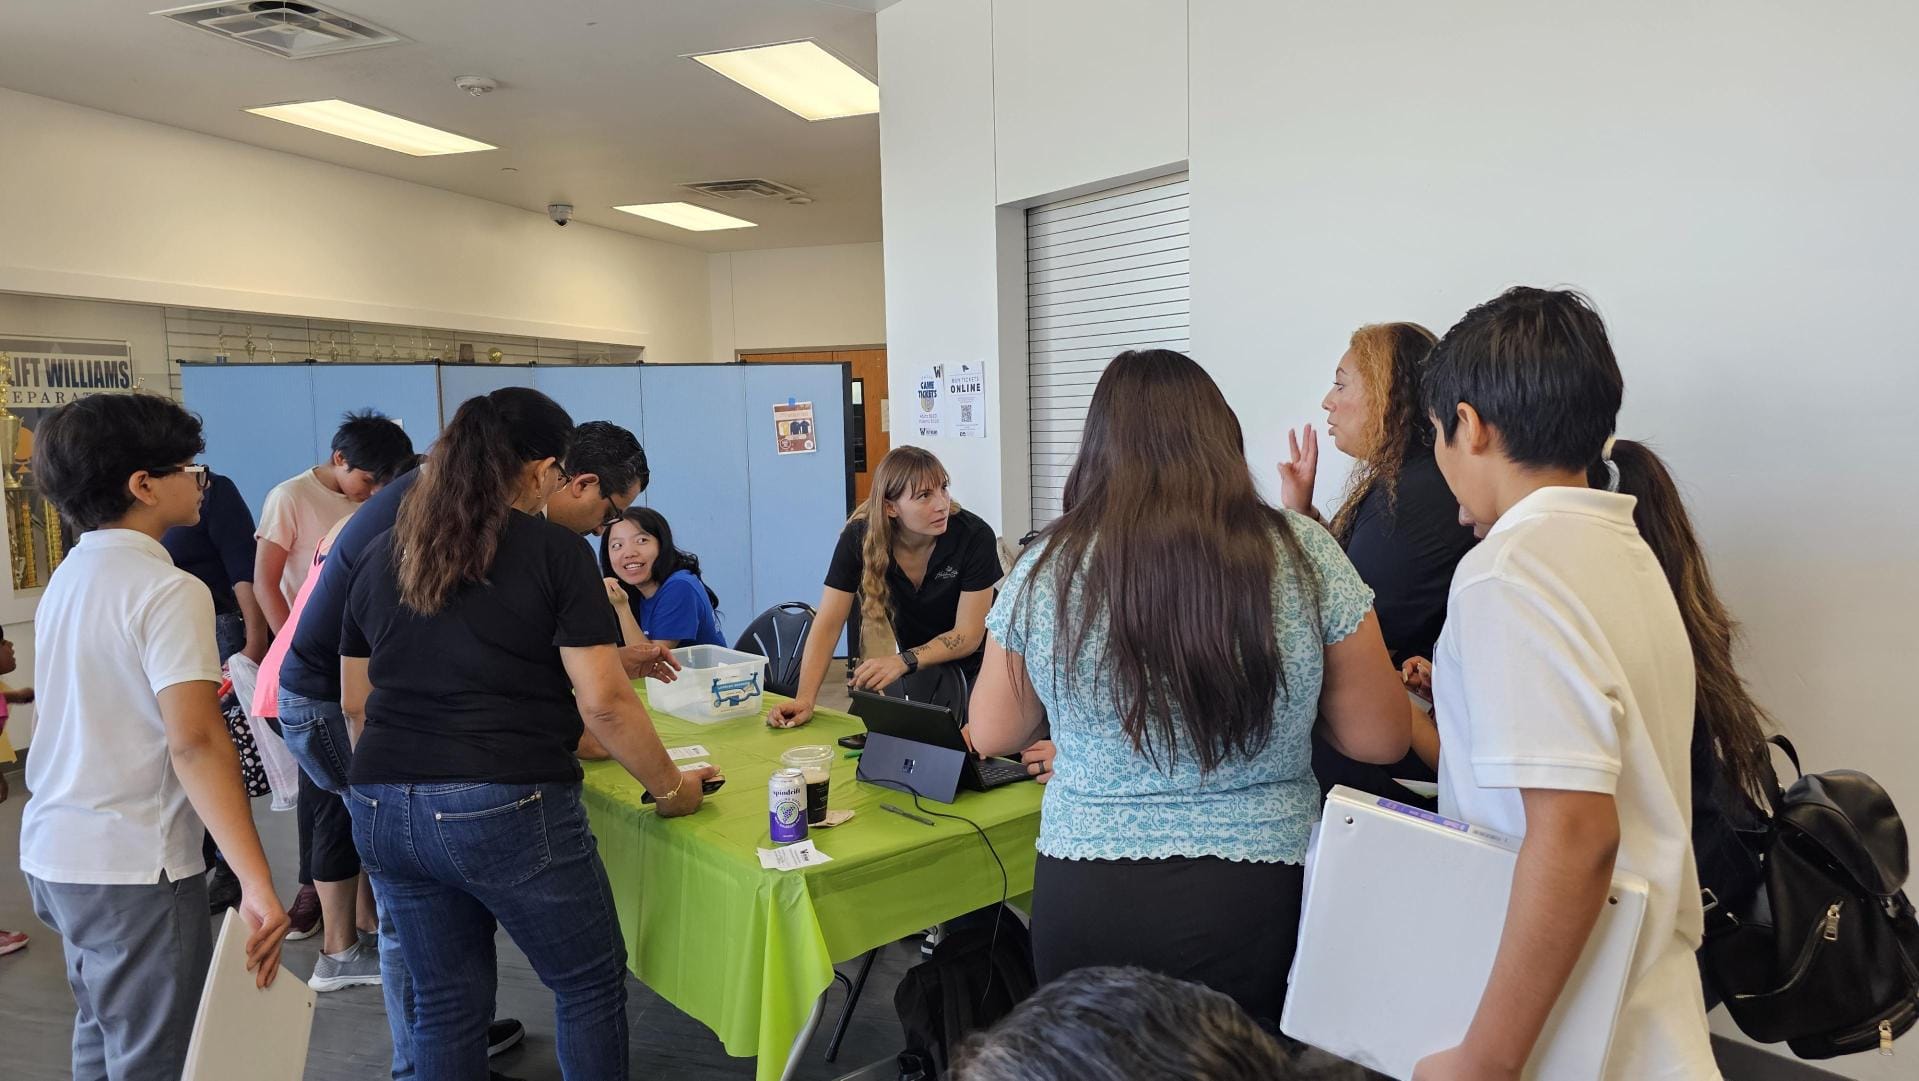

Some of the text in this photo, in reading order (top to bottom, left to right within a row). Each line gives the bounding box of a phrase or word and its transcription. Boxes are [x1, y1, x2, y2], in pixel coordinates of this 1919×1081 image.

[44, 358, 130, 389] WILLIAMS
[951, 383, 980, 393] ONLINE
[918, 390, 937, 398] TICKETS
[773, 787, 800, 797] spindrift
